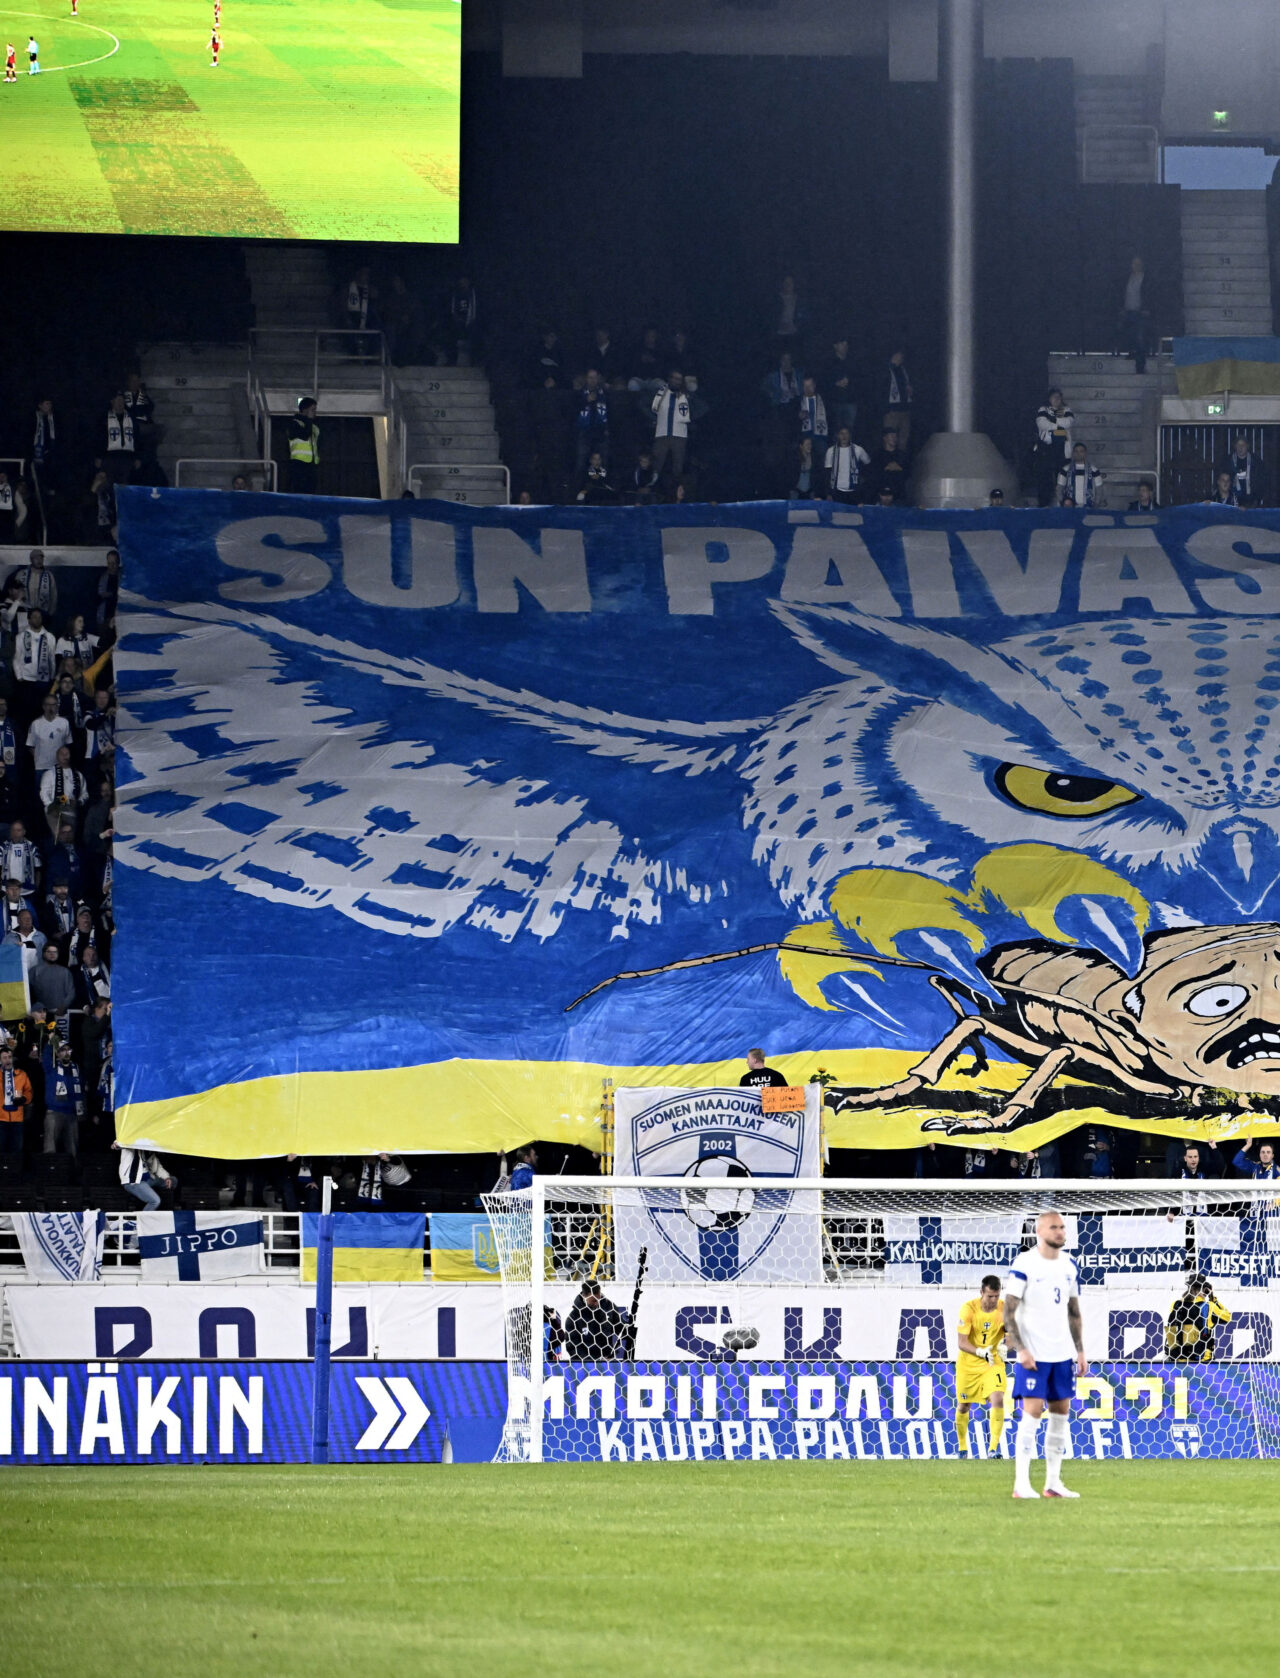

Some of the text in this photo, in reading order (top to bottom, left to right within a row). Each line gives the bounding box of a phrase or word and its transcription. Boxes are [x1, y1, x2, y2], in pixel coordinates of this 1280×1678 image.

[217, 514, 592, 613] SUN
[639, 1103, 691, 1132] SUOMEN
[672, 1114, 765, 1133] KANNATTAJAT
[702, 1140, 732, 1151] 2002
[161, 1228, 238, 1256] JIPPO
[1053, 1287, 1061, 1304] 3
[0, 1362, 264, 1455] NÄKIN
